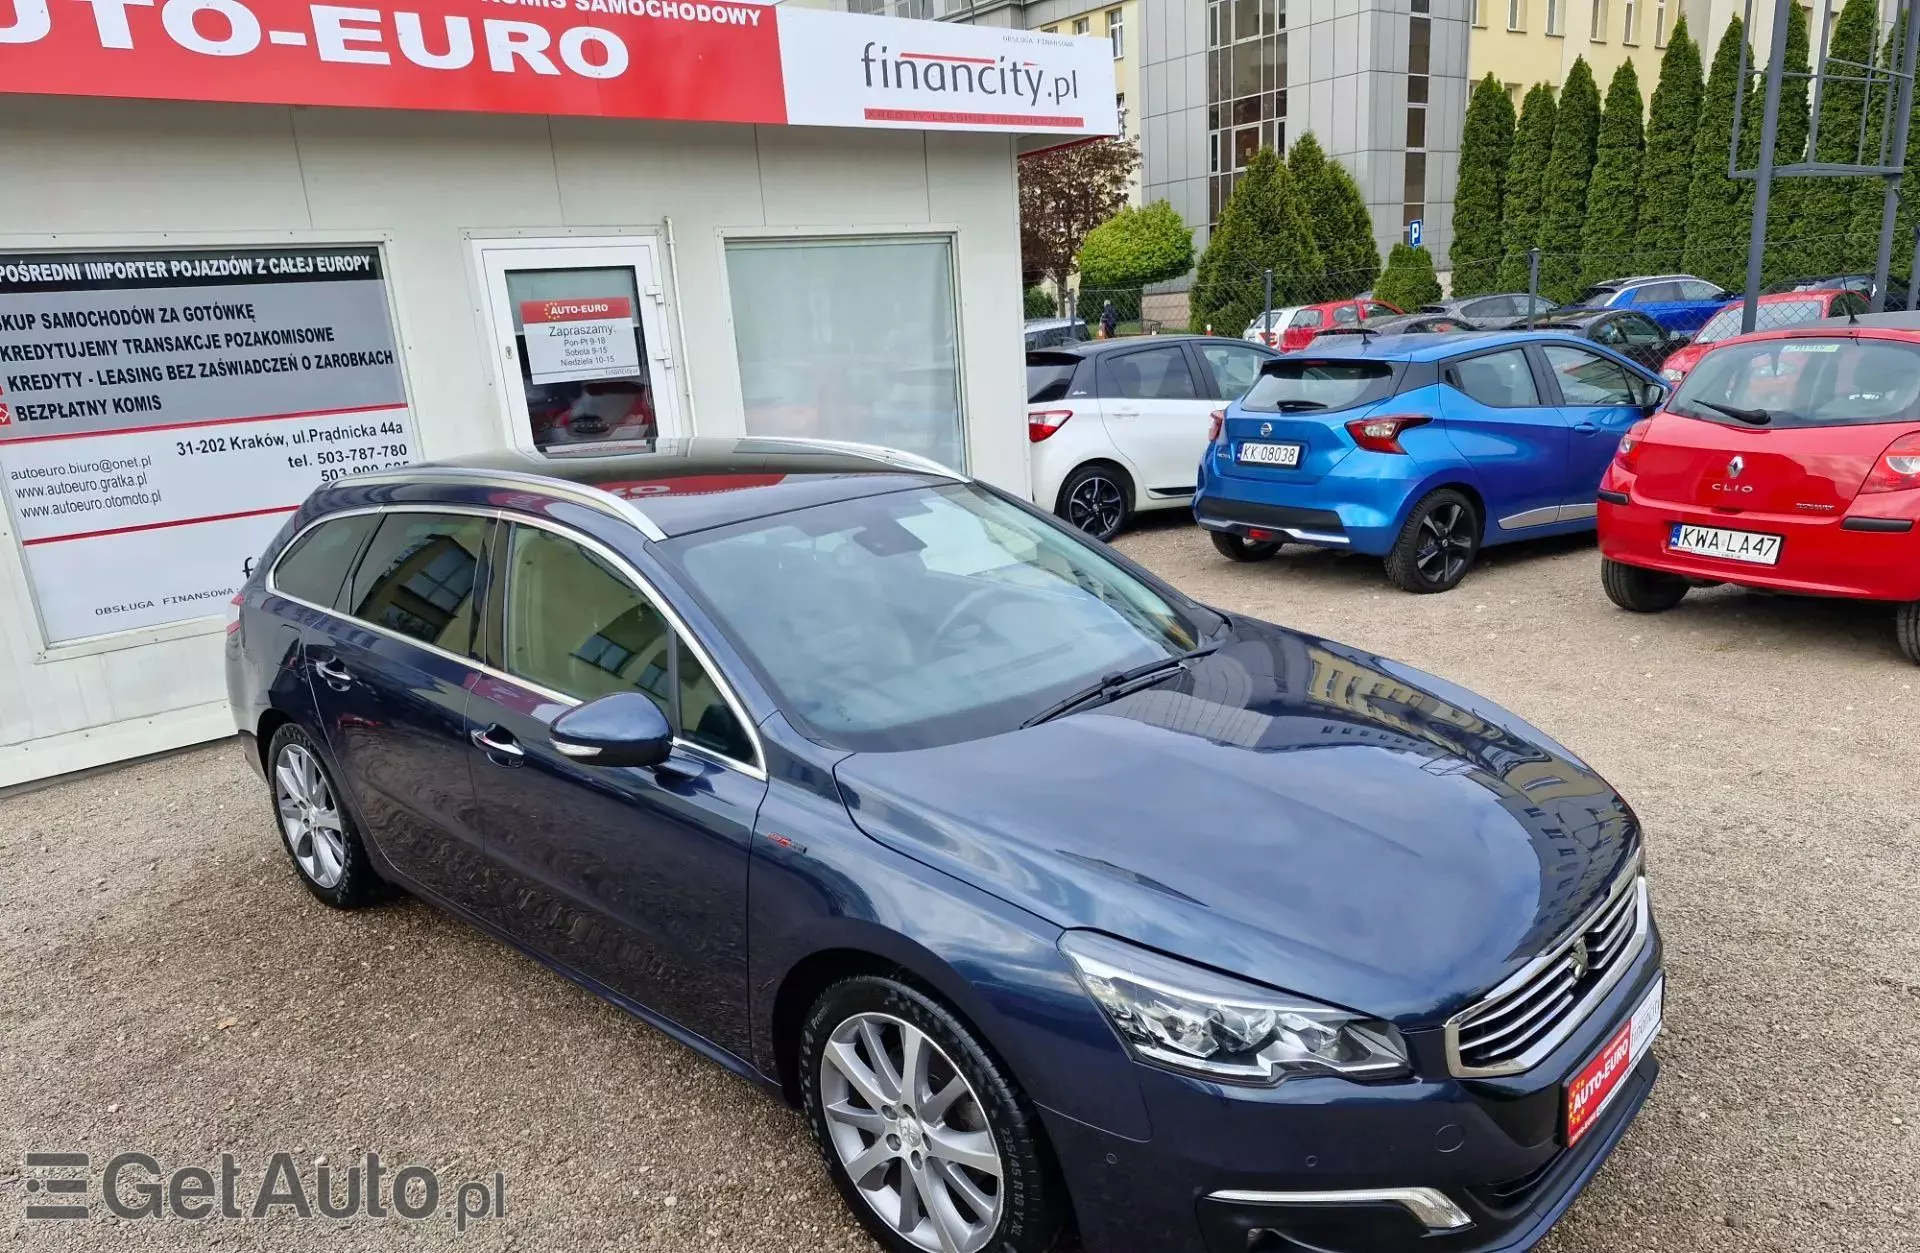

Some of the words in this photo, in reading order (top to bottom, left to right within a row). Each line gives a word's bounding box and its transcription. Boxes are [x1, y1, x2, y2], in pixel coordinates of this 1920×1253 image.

[575, 0, 761, 27] SAMOCHODOWY
[861, 42, 1079, 106] financity.pl
[1411, 222, 1420, 244] P
[84, 261, 169, 280] IMPORTER
[170, 255, 253, 278] POJAZDÓW
[255, 258, 267, 275] Z
[269, 256, 314, 274] CAŁEJ
[316, 255, 370, 273] EUROPY
[0, 313, 36, 332] KUP
[41, 305, 155, 330] SAMOCHODÓW
[158, 306, 180, 324] ZA
[183, 302, 256, 323] GOTÓWKĘ
[550, 303, 608, 315] AUTO-EURO
[0, 339, 118, 362] KREDYTUJEMY
[122, 333, 222, 354] TRANSAKCJE
[224, 326, 335, 348] POZAKOMISOWE
[565, 347, 590, 357] Sobota
[591, 346, 608, 355] 9-15
[7, 371, 83, 393] KREDYTY
[97, 365, 163, 386] LEASING
[166, 363, 197, 381] BEZ
[200, 353, 299, 378] ZAŚWIADCZEŃ
[301, 355, 312, 371] O
[314, 349, 394, 370] ZAROBKACH
[560, 357, 593, 367] Niedziela
[595, 354, 615, 365] 10-15
[15, 398, 108, 422] BEZPŁATNY
[112, 394, 162, 414] KOMIS
[176, 438, 227, 456] 31-202
[230, 432, 289, 452] Kraków,
[292, 424, 377, 445] ul.Prądnicka
[380, 421, 403, 436] 44a
[10, 454, 152, 480] autoeuro.biuro@onet.pl
[287, 454, 313, 469] tel.
[317, 443, 408, 466] 503-787-780
[1243, 444, 1258, 460] KK
[1261, 446, 1296, 463] 08038
[15, 471, 148, 499] www.autoeuro.gratka.pl
[1712, 483, 1753, 493] CLIO
[20, 489, 162, 519] www.autoeuro.otomoto.pl
[1681, 527, 1719, 550] KWA
[1726, 533, 1777, 557] LA47
[95, 600, 155, 616] OBSŁUGA
[1573, 1037, 1629, 1114] AUTO-EURO
